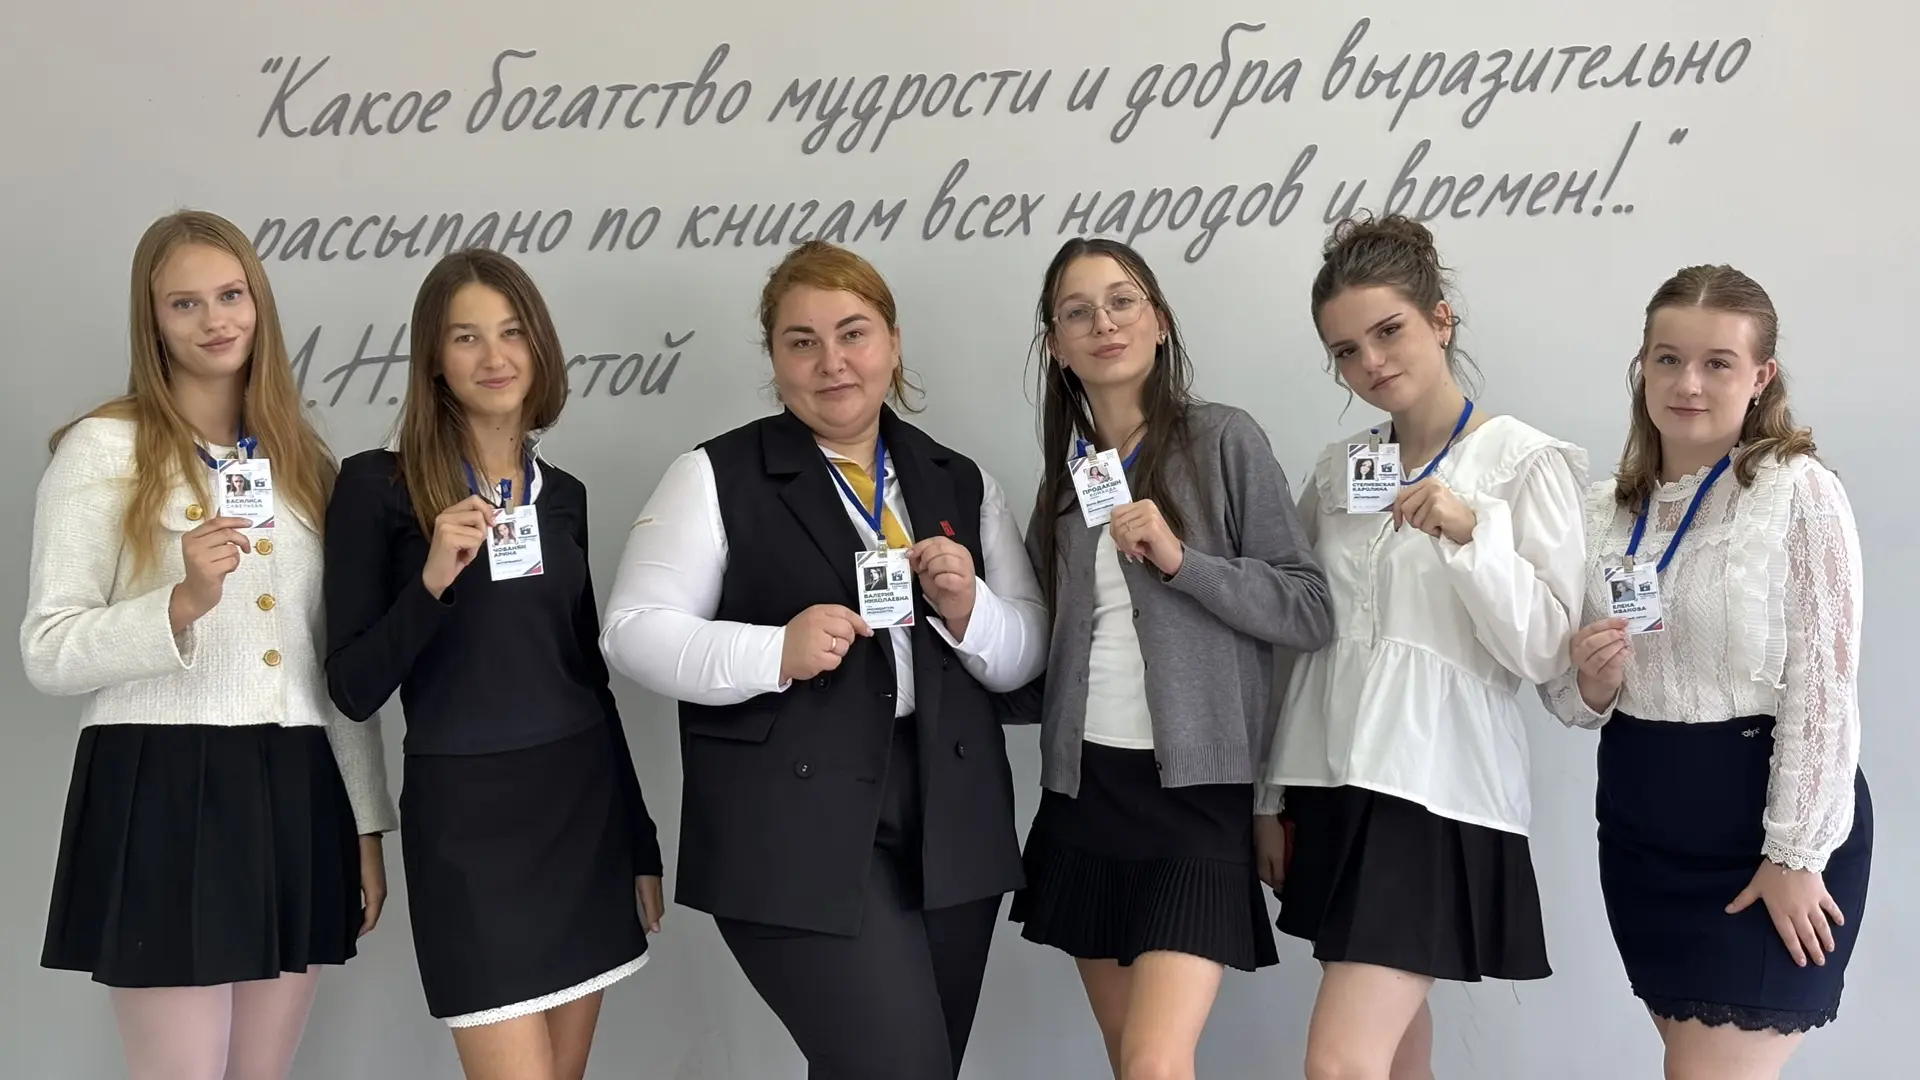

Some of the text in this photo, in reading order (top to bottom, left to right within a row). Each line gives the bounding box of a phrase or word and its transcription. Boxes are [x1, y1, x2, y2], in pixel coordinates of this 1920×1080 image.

[257, 17, 1752, 155] "Какое богатство мудрости и добра выразительно
[252, 208, 573, 263] рассыпано
[588, 206, 662, 252] по
[677, 199, 908, 249] книгам
[921, 158, 1046, 242] всех
[1057, 144, 1319, 264] народов
[1322, 178, 1367, 226] и
[864, 591, 894, 599] ВАЛЕРИЯ
[864, 595, 909, 604] НИКОЛАЕВНА
[1613, 606, 1647, 614] ИВАНОВА
